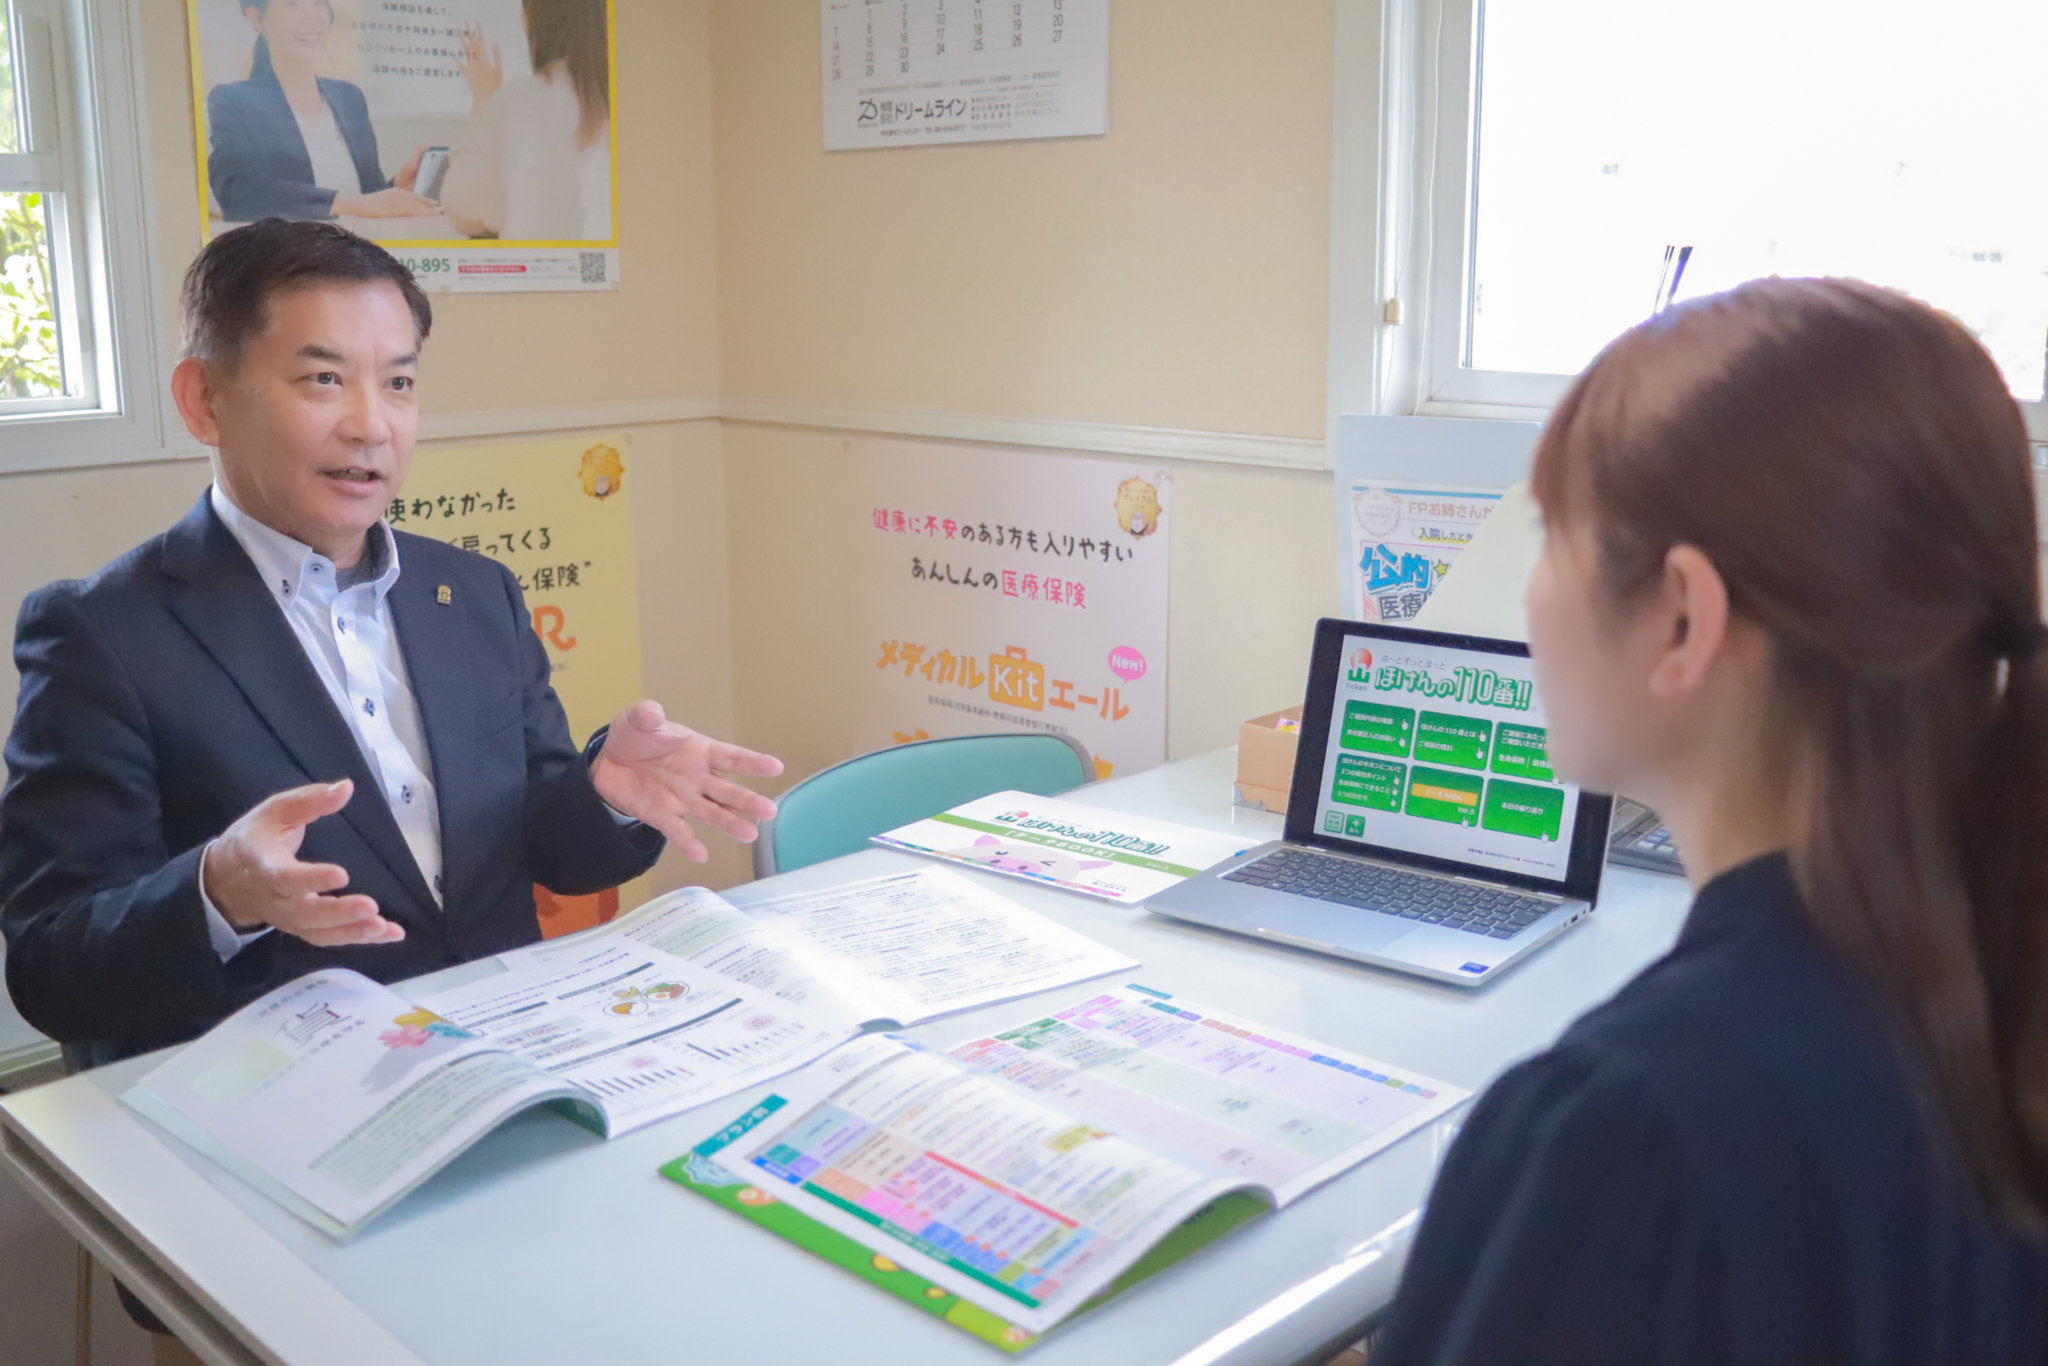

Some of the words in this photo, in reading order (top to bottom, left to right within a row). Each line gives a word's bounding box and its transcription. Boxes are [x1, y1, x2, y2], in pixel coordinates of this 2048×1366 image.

[936, 13, 945, 25] 10
[973, 8, 982, 20] 11
[1012, 3, 1022, 15] 12
[1053, 0, 1062, 10] 13
[936, 28, 945, 39] 17
[974, 23, 983, 35] 18
[1013, 18, 1022, 31] 19
[1053, 14, 1063, 27] 20
[936, 43, 945, 55] 24
[973, 38, 983, 51] 25
[1012, 34, 1022, 47] 26
[1052, 30, 1063, 42] 27
[900, 61, 909, 73] 30
[894, 98, 967, 121] ドリームライン
[384, 488, 516, 525] 使わなかった
[450, 527, 551, 557] 戻ってくる
[872, 507, 1133, 562] 健康に不安のある方も入りやすい
[1359, 543, 1430, 592] 公的
[911, 556, 1087, 610] あんしんの医療保険
[1378, 590, 1433, 621] 医療
[533, 605, 577, 652] R
[1112, 653, 1144, 674] New!
[1345, 682, 1368, 692] hoken
